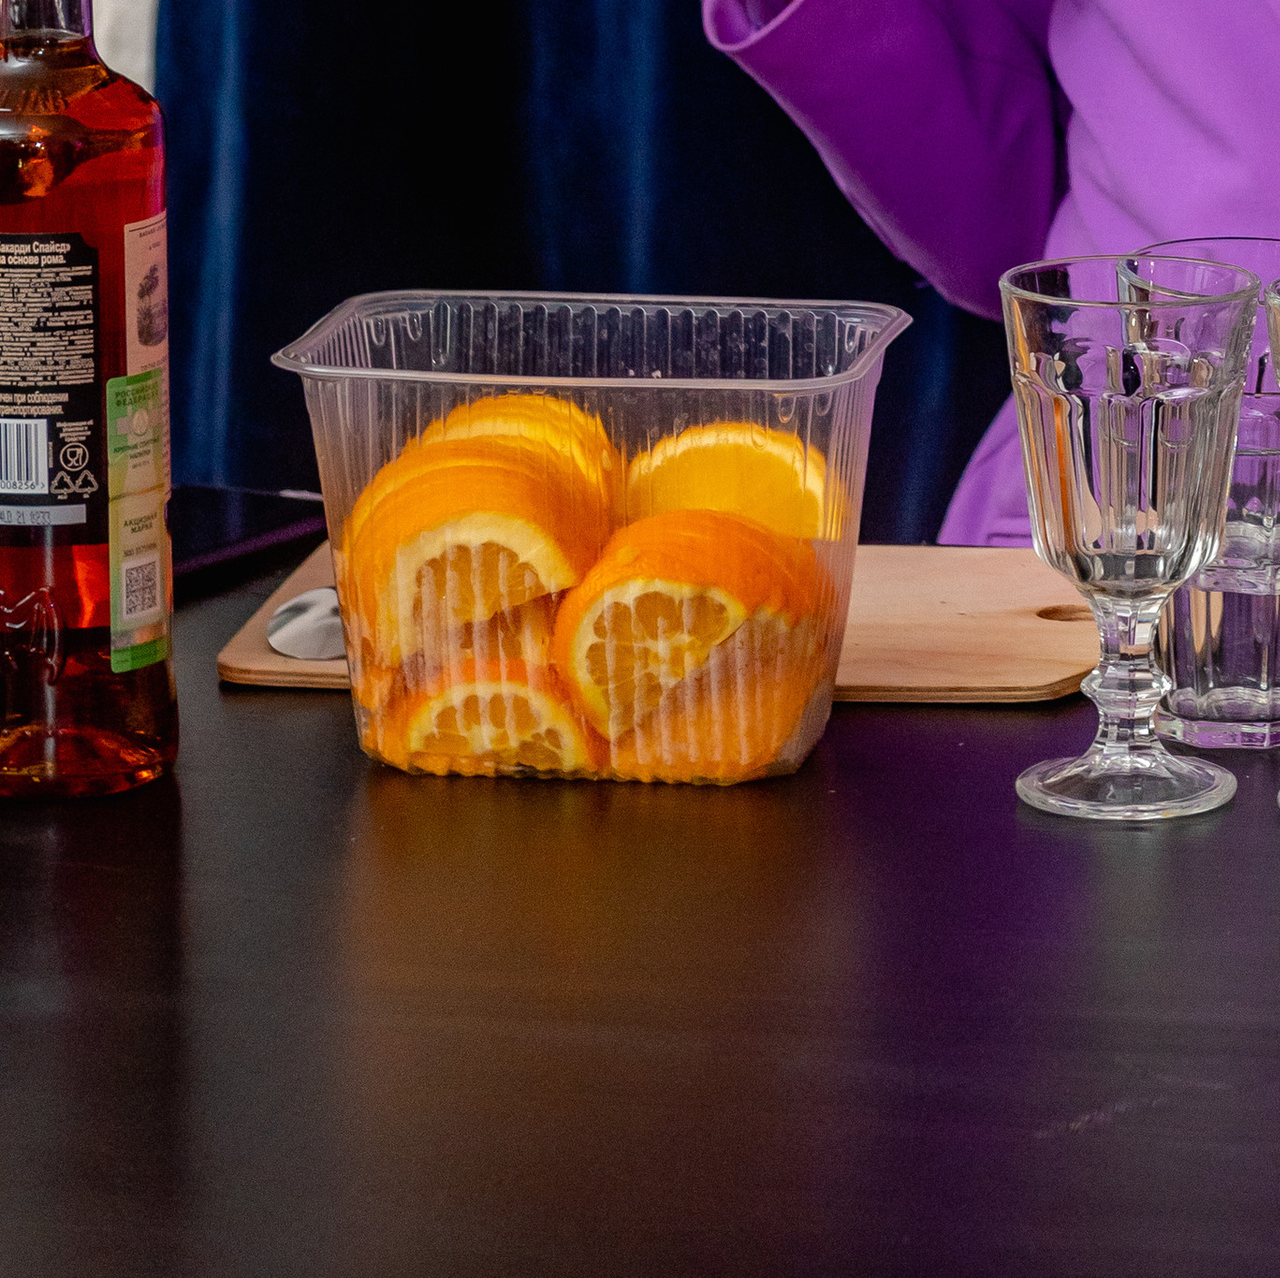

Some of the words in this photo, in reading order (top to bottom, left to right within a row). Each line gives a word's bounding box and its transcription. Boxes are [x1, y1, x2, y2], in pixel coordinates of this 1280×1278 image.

[0, 243, 31, 256] акарди
[7, 255, 39, 265] основе
[41, 254, 66, 267] рома.
